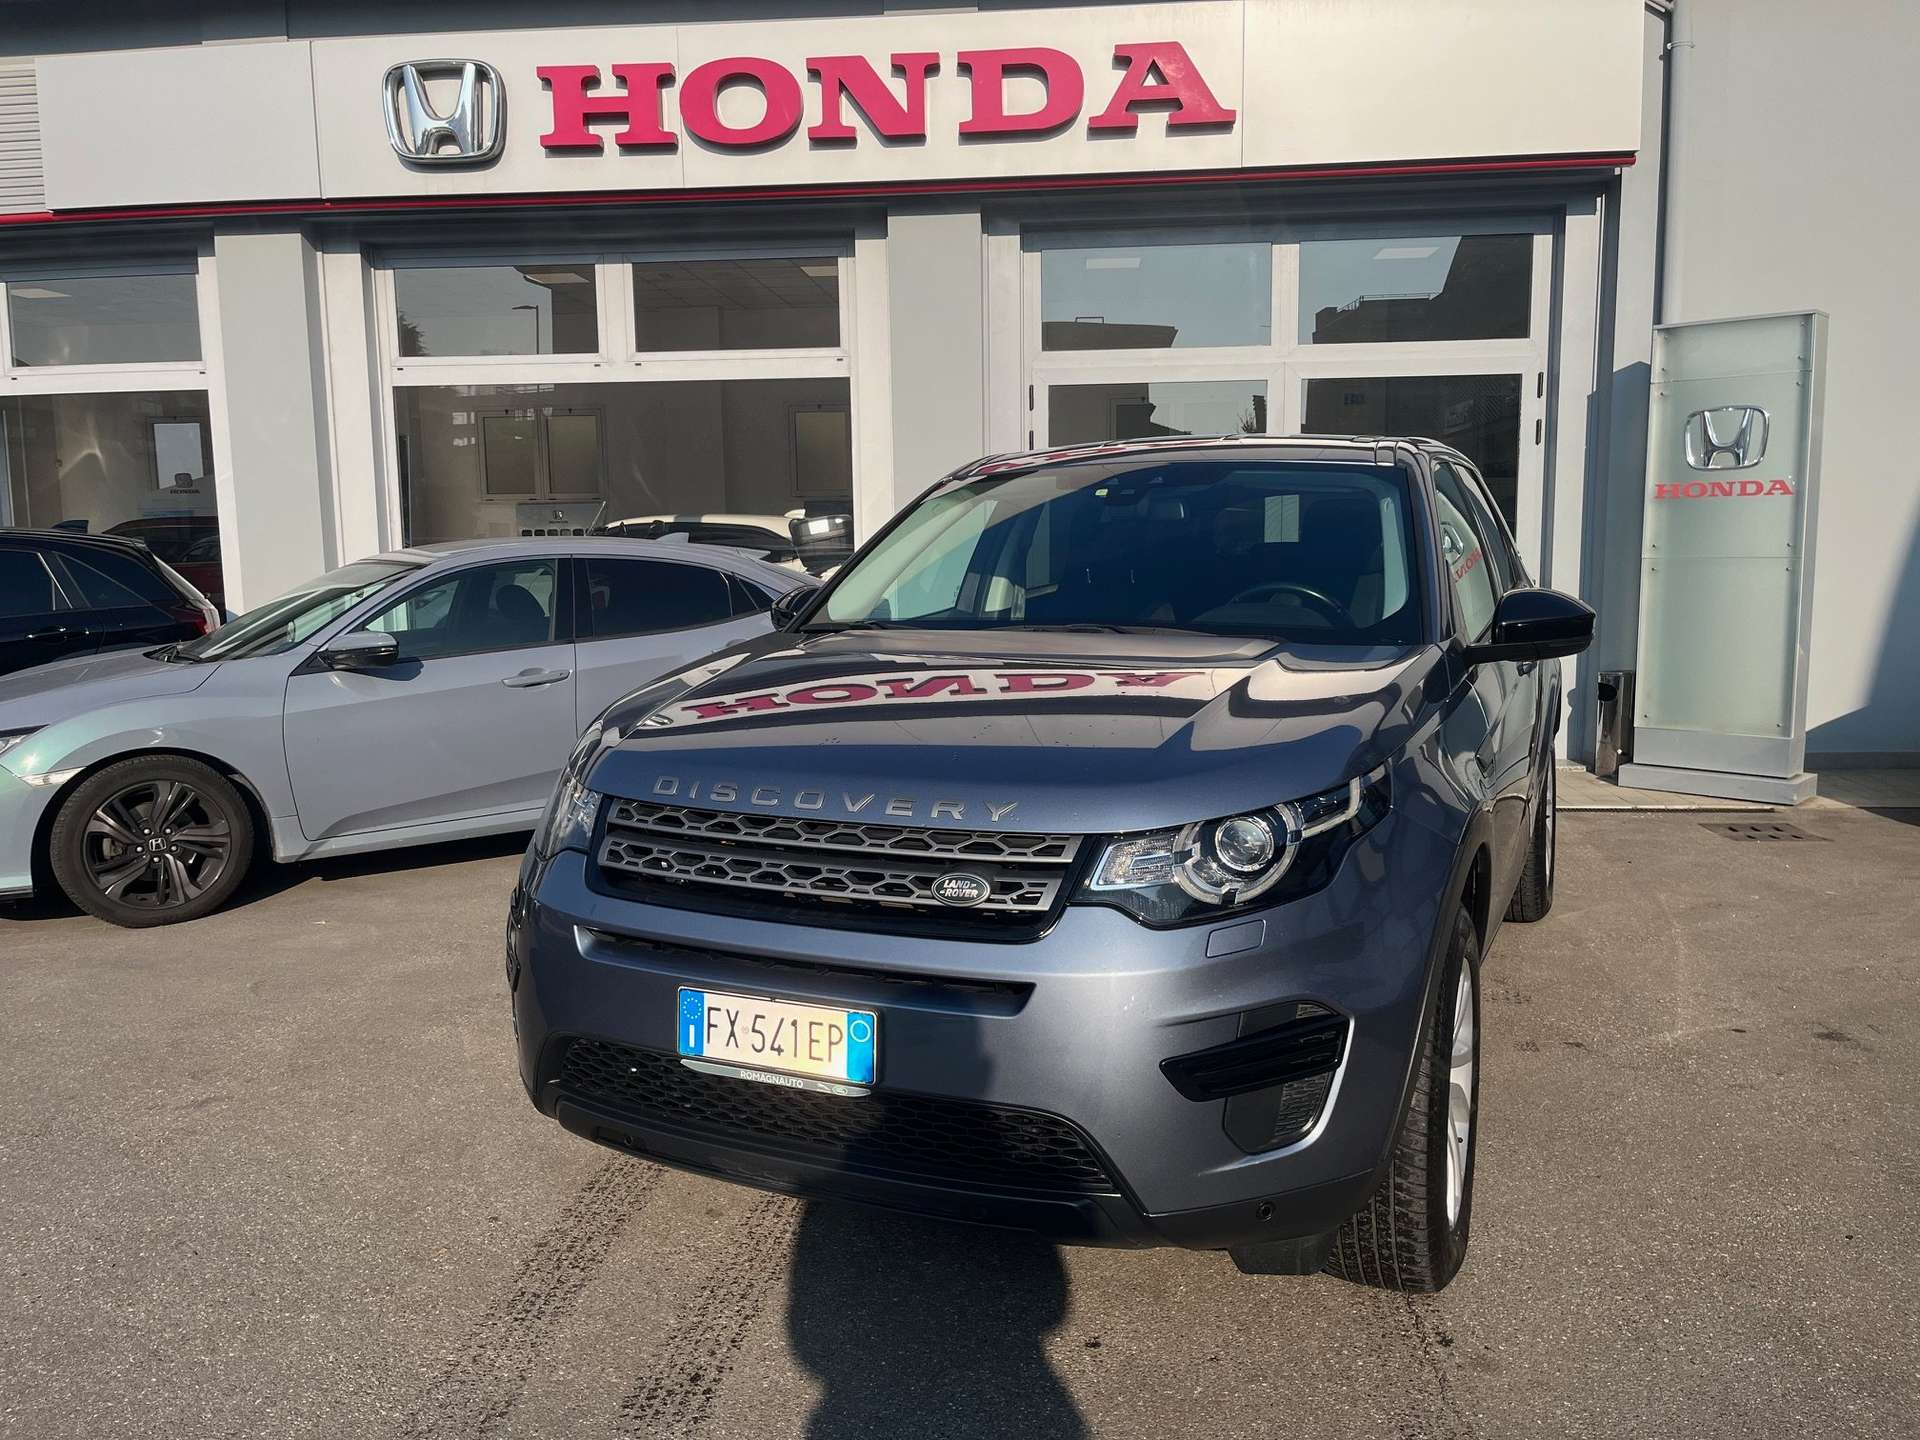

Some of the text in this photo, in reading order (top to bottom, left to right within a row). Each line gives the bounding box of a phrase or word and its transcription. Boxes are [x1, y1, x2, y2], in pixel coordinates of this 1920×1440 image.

[537, 41, 1236, 153] HONDA
[1654, 479, 1794, 500] HONDA
[652, 775, 1018, 822] DISCOVERY
[943, 880, 971, 889] LAND
[944, 889, 979, 898] ROVER
[740, 1070, 804, 1088] ROMAGNAUTO
